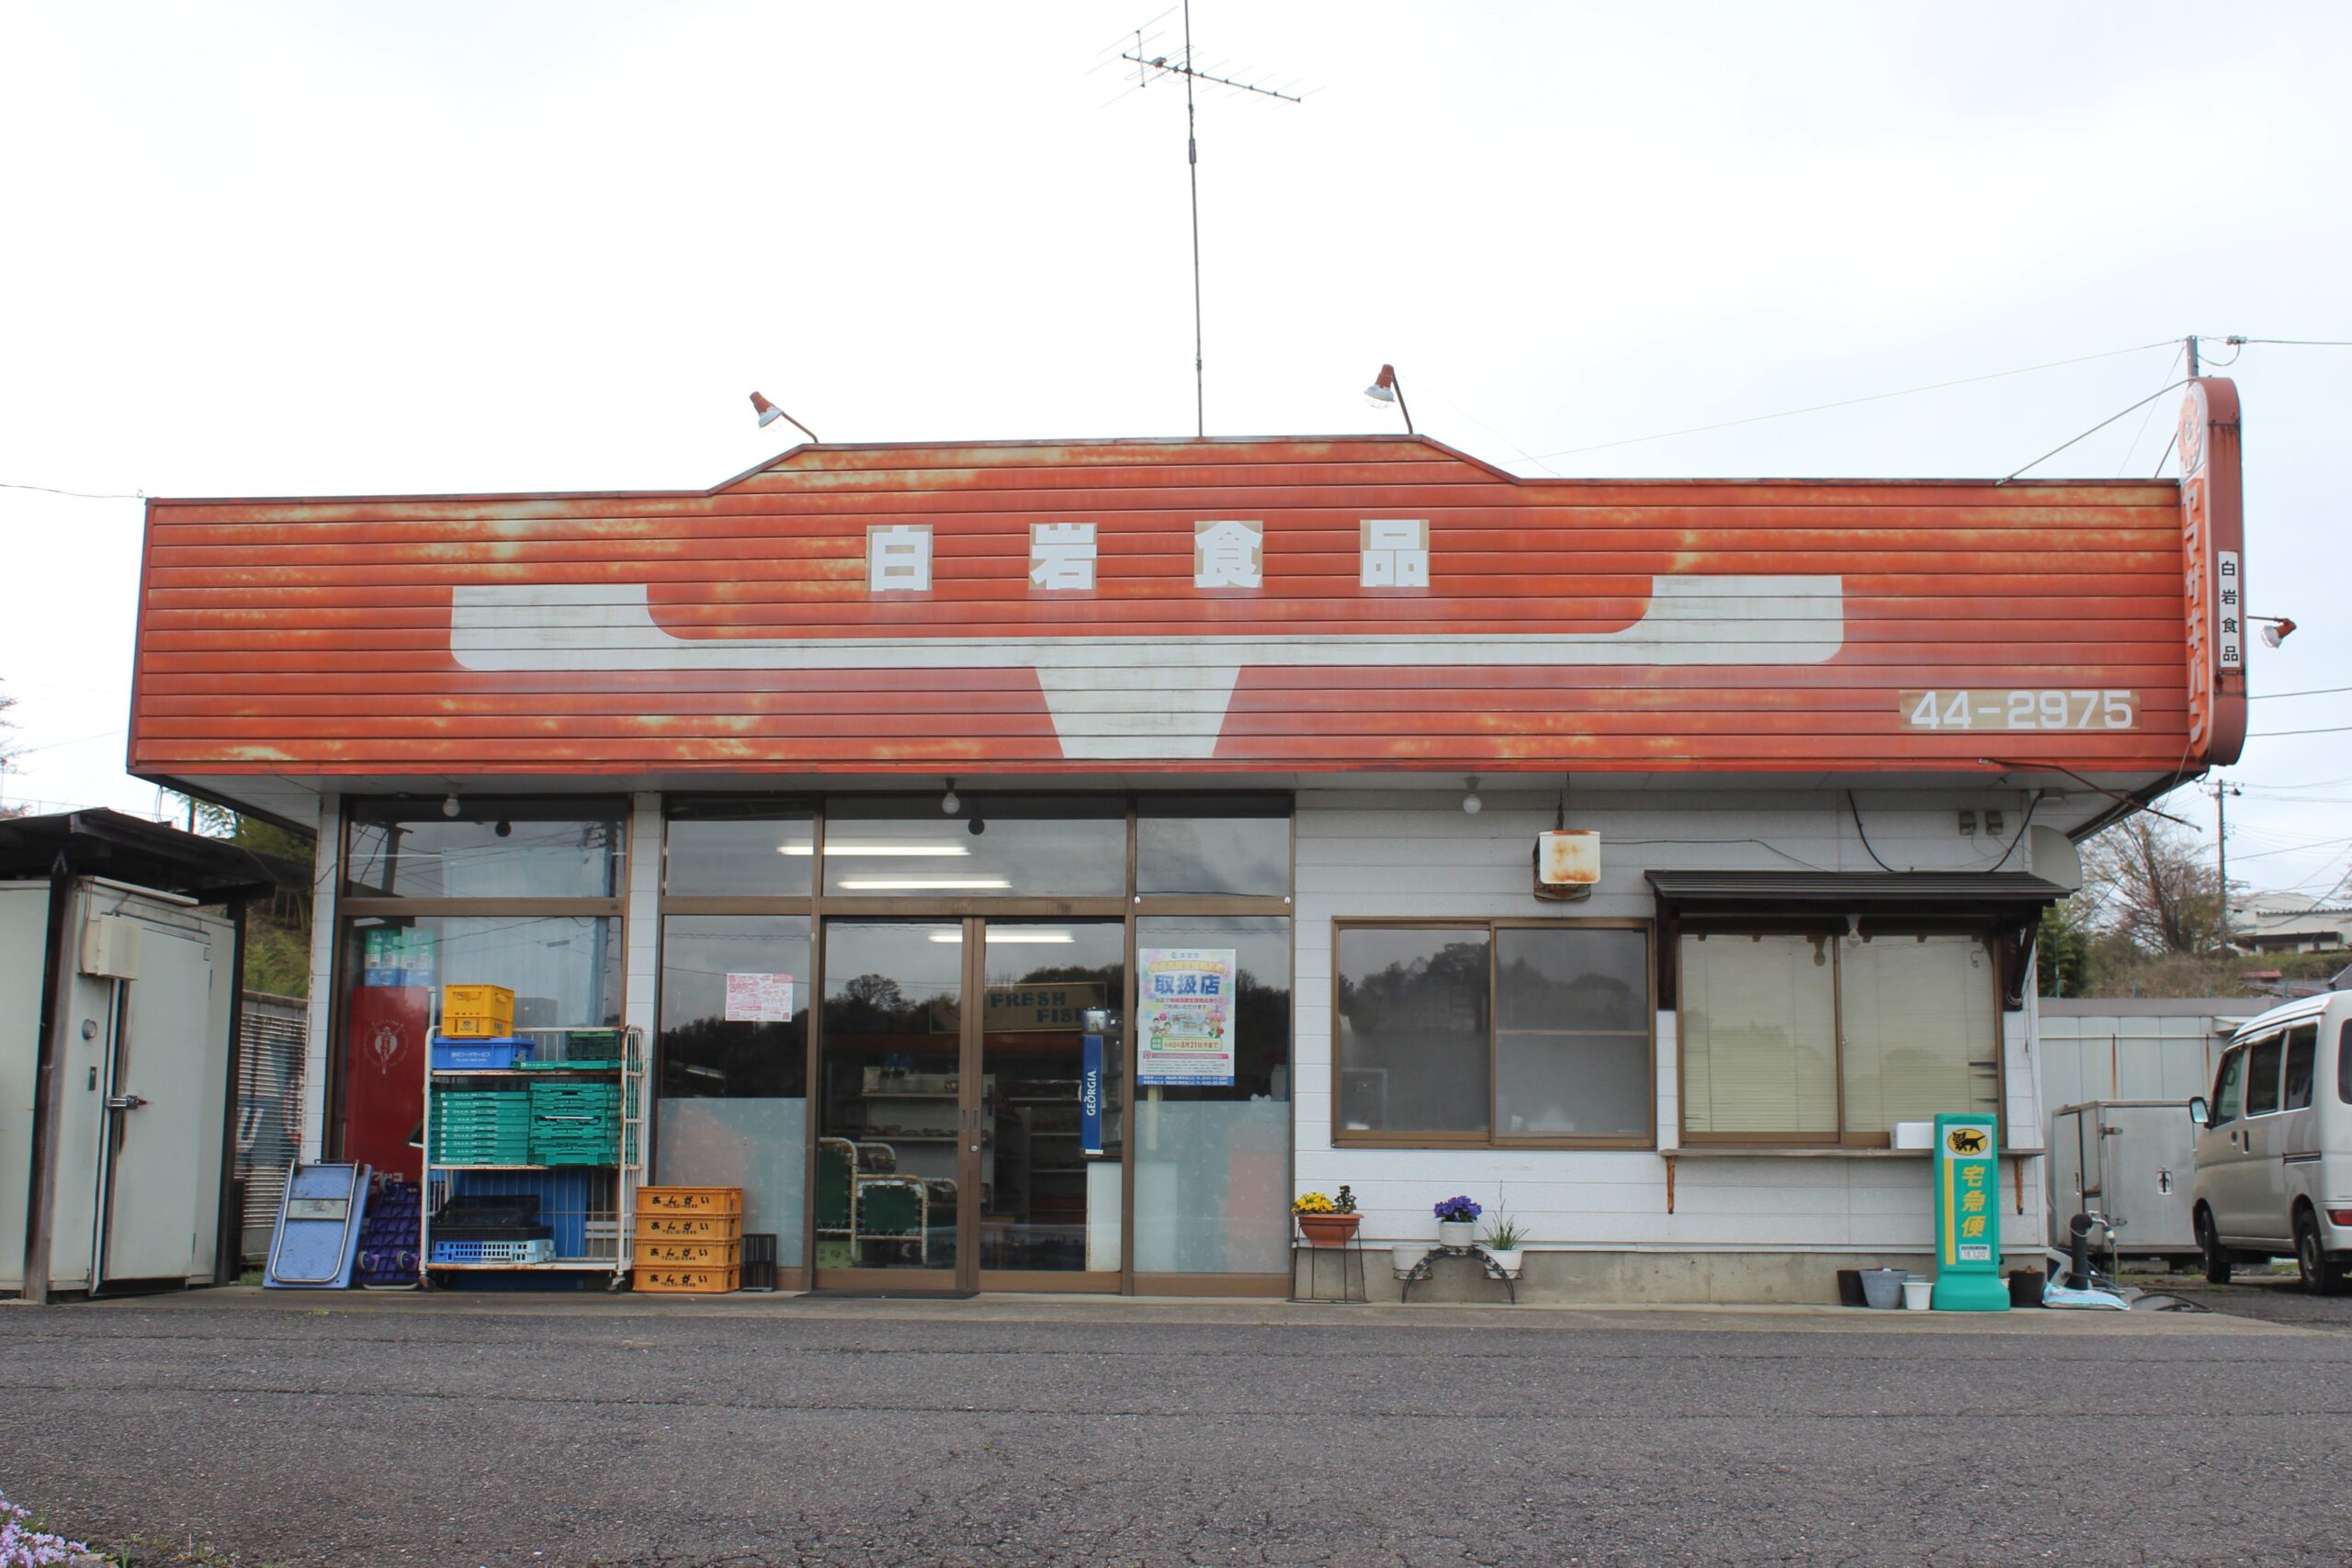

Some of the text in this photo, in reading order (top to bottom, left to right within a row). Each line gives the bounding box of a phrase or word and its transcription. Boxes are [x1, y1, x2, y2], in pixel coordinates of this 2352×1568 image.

[871, 519, 1428, 592] 白岩食品
[2182, 483, 2202, 744] ヤマザキパン
[2221, 560, 2239, 662] 白岩食品
[1911, 691, 2133, 729] 44-2975
[990, 992, 1066, 1008] FRESH
[1154, 975, 1221, 995] 取扱店
[1086, 1069, 1097, 1116] GEORGIA
[1961, 1165, 1986, 1237] 宅急便
